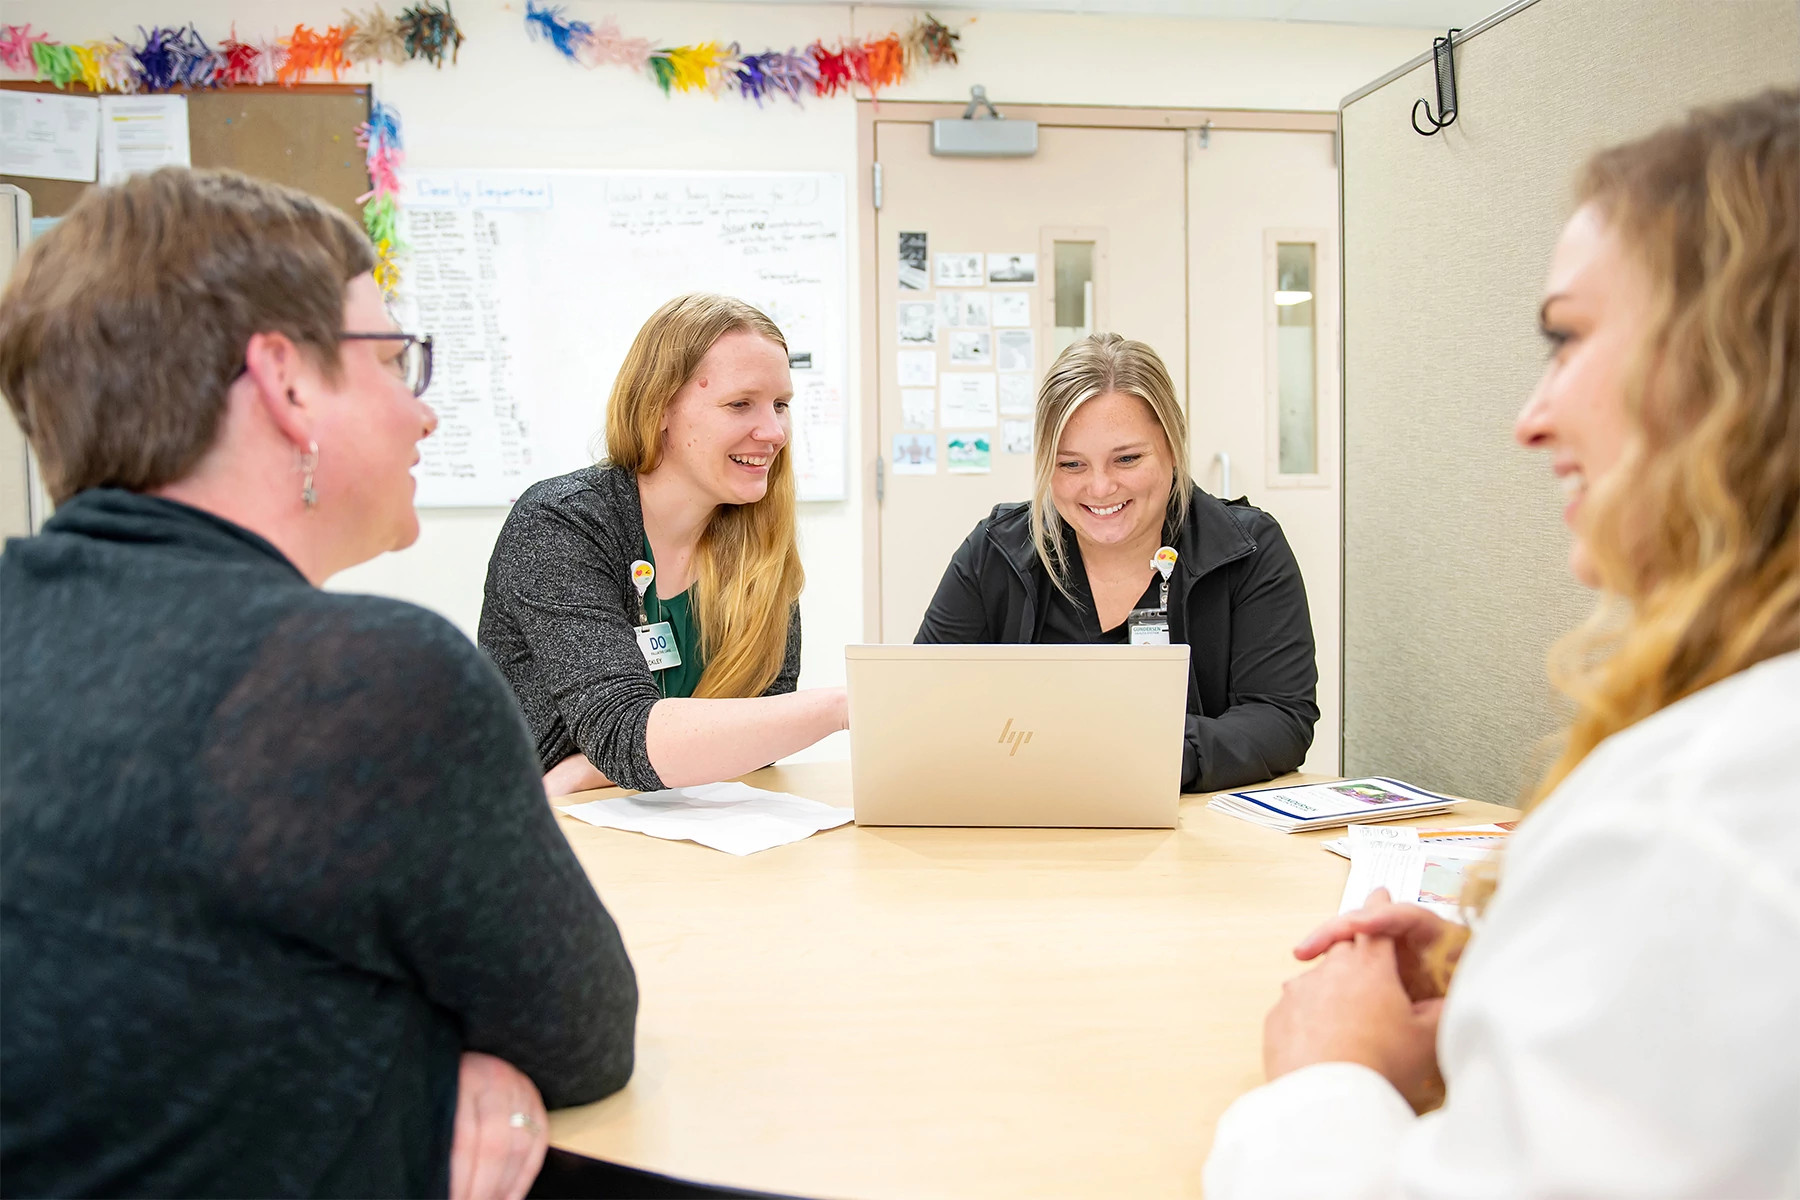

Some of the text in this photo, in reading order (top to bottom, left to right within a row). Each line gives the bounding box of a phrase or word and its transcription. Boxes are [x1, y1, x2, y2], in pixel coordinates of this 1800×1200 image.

[649, 635, 666, 650] DO
[648, 658, 662, 666] CKLEY
[998, 718, 1034, 757] hp
